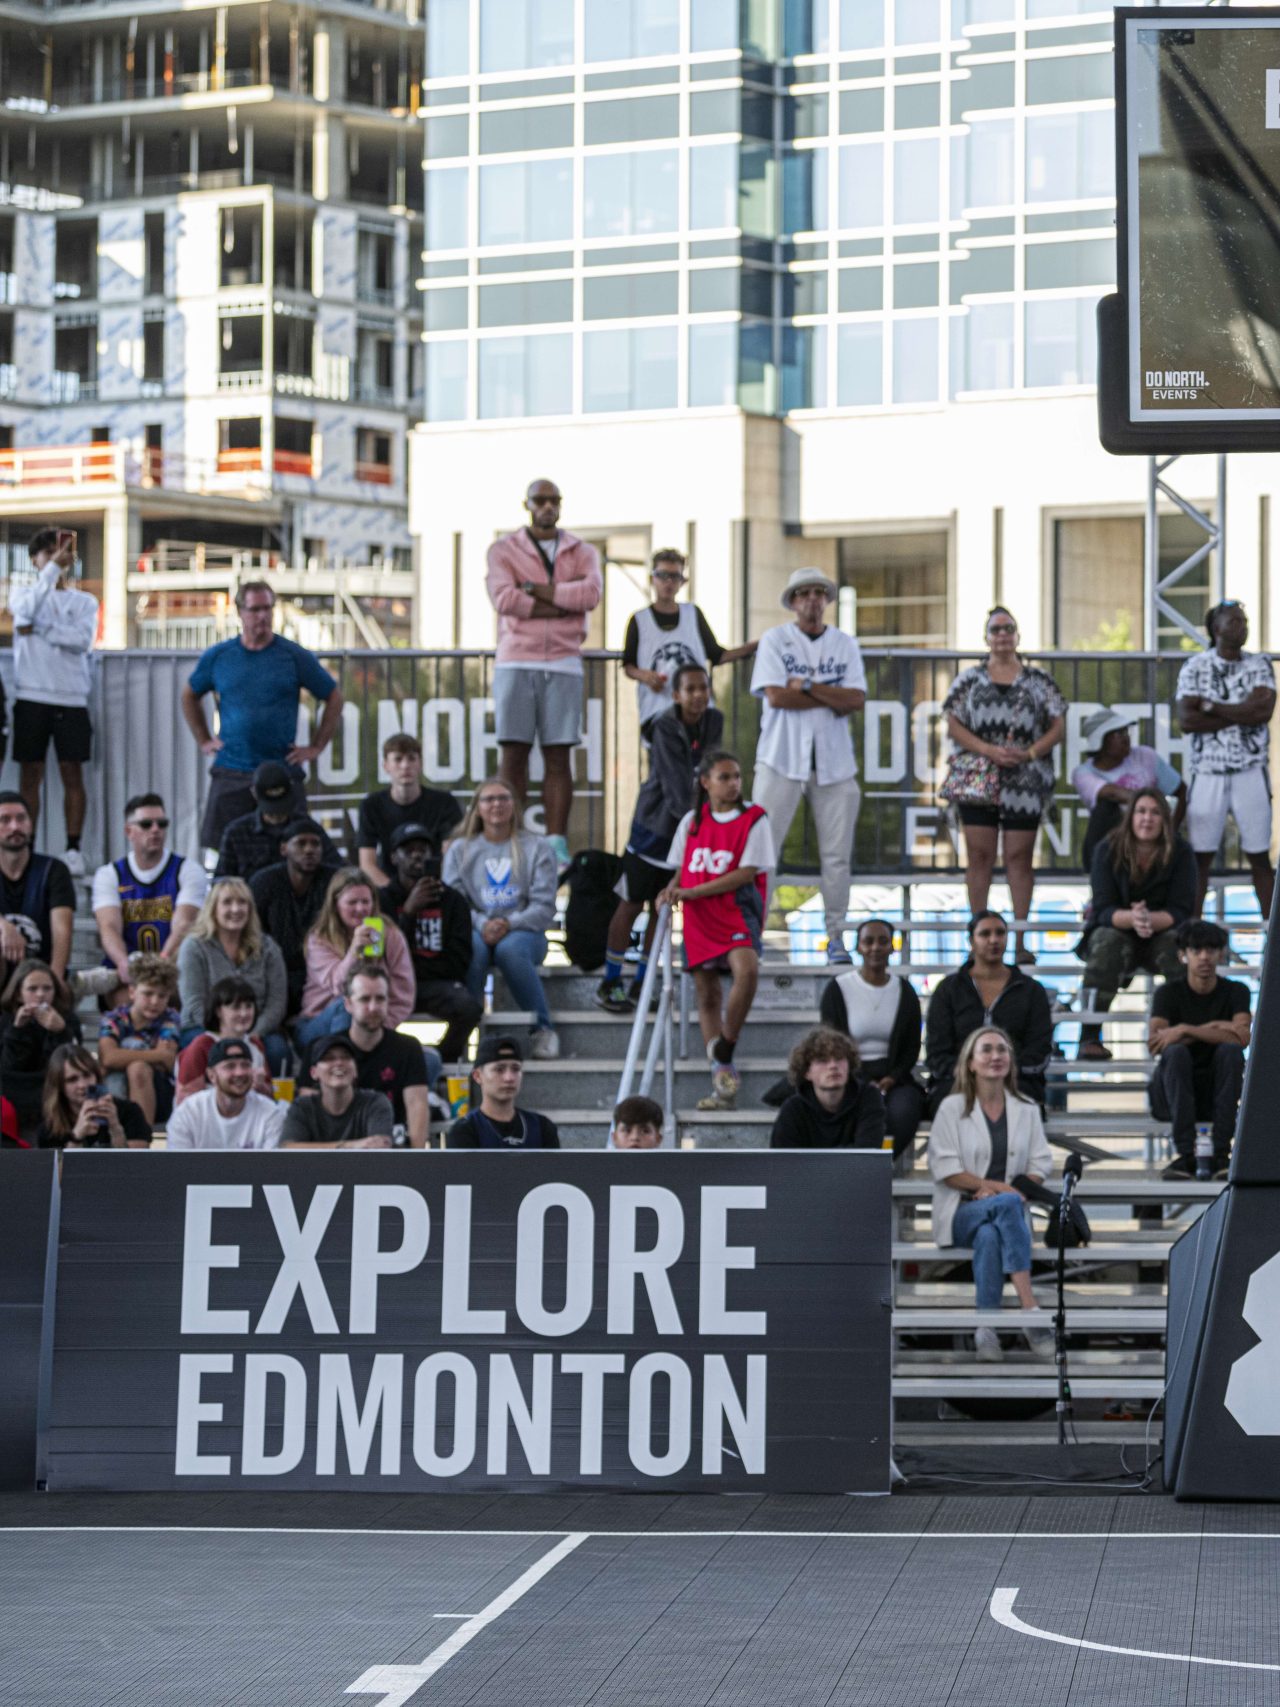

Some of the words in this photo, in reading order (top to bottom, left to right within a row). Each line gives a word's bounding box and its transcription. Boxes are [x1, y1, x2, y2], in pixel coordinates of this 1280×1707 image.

[1145, 371, 1163, 387] DO
[1164, 371, 1205, 387] NORTH
[1152, 389, 1198, 400] EVENTS
[180, 1182, 768, 1337] EXPLORE
[175, 1351, 768, 1478] EDMONTON
